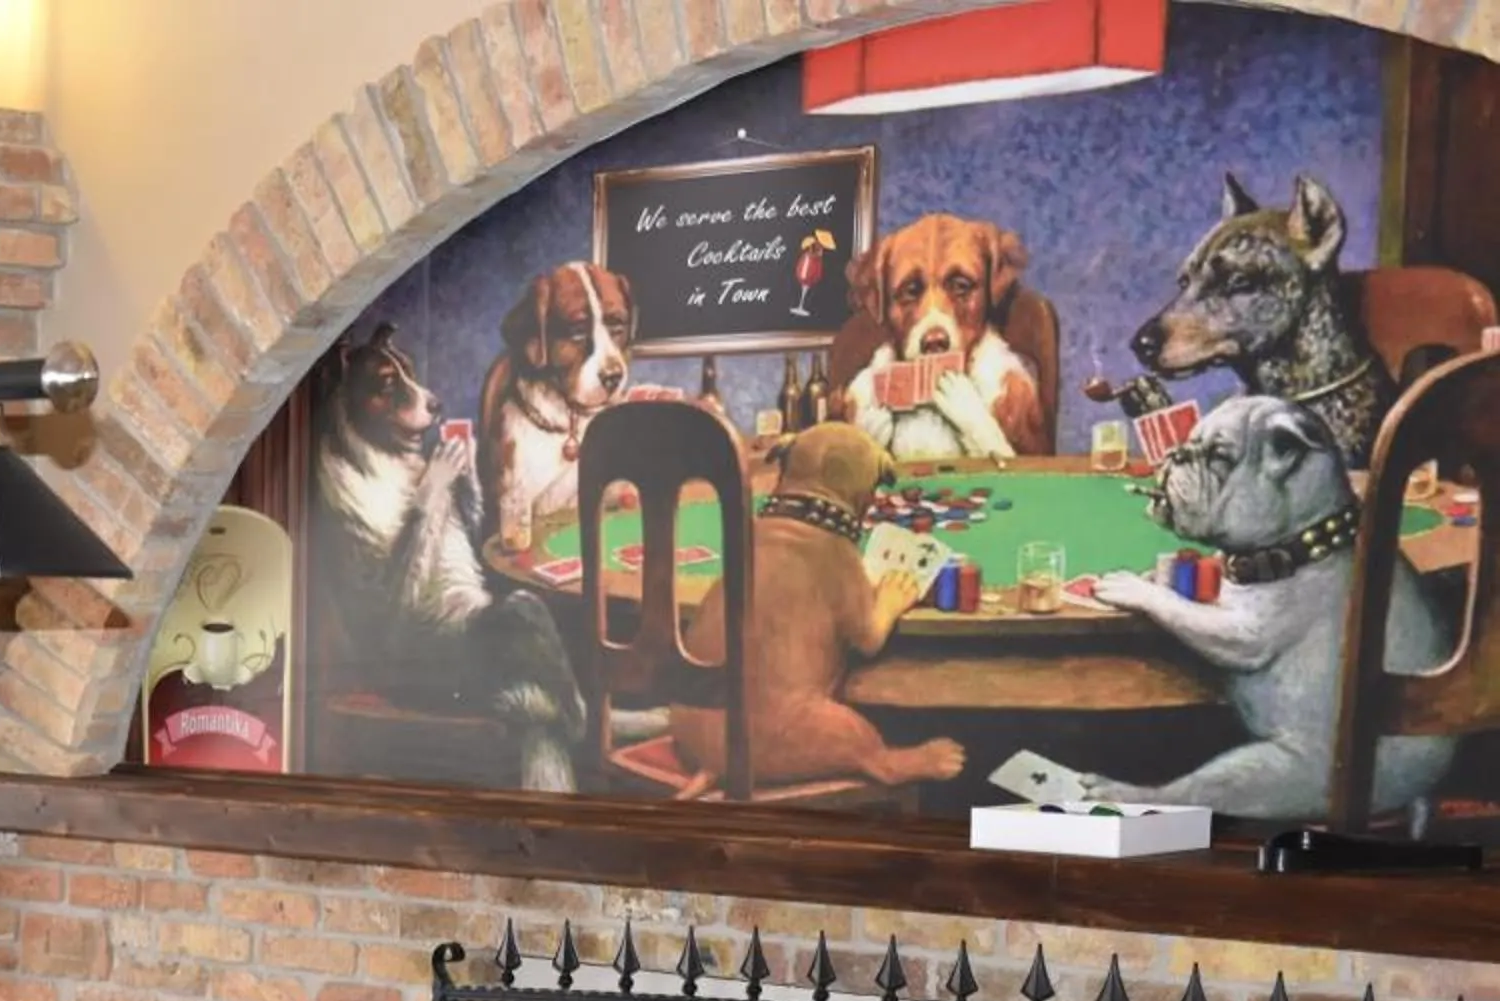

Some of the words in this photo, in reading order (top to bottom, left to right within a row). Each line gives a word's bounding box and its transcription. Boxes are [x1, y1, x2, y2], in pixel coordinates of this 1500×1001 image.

[636, 205, 667, 232] We
[676, 209, 732, 228] serve
[743, 197, 777, 222] the
[786, 194, 837, 217] best
[687, 235, 787, 268] Cocktails
[687, 286, 705, 306] in
[717, 278, 770, 305] Town
